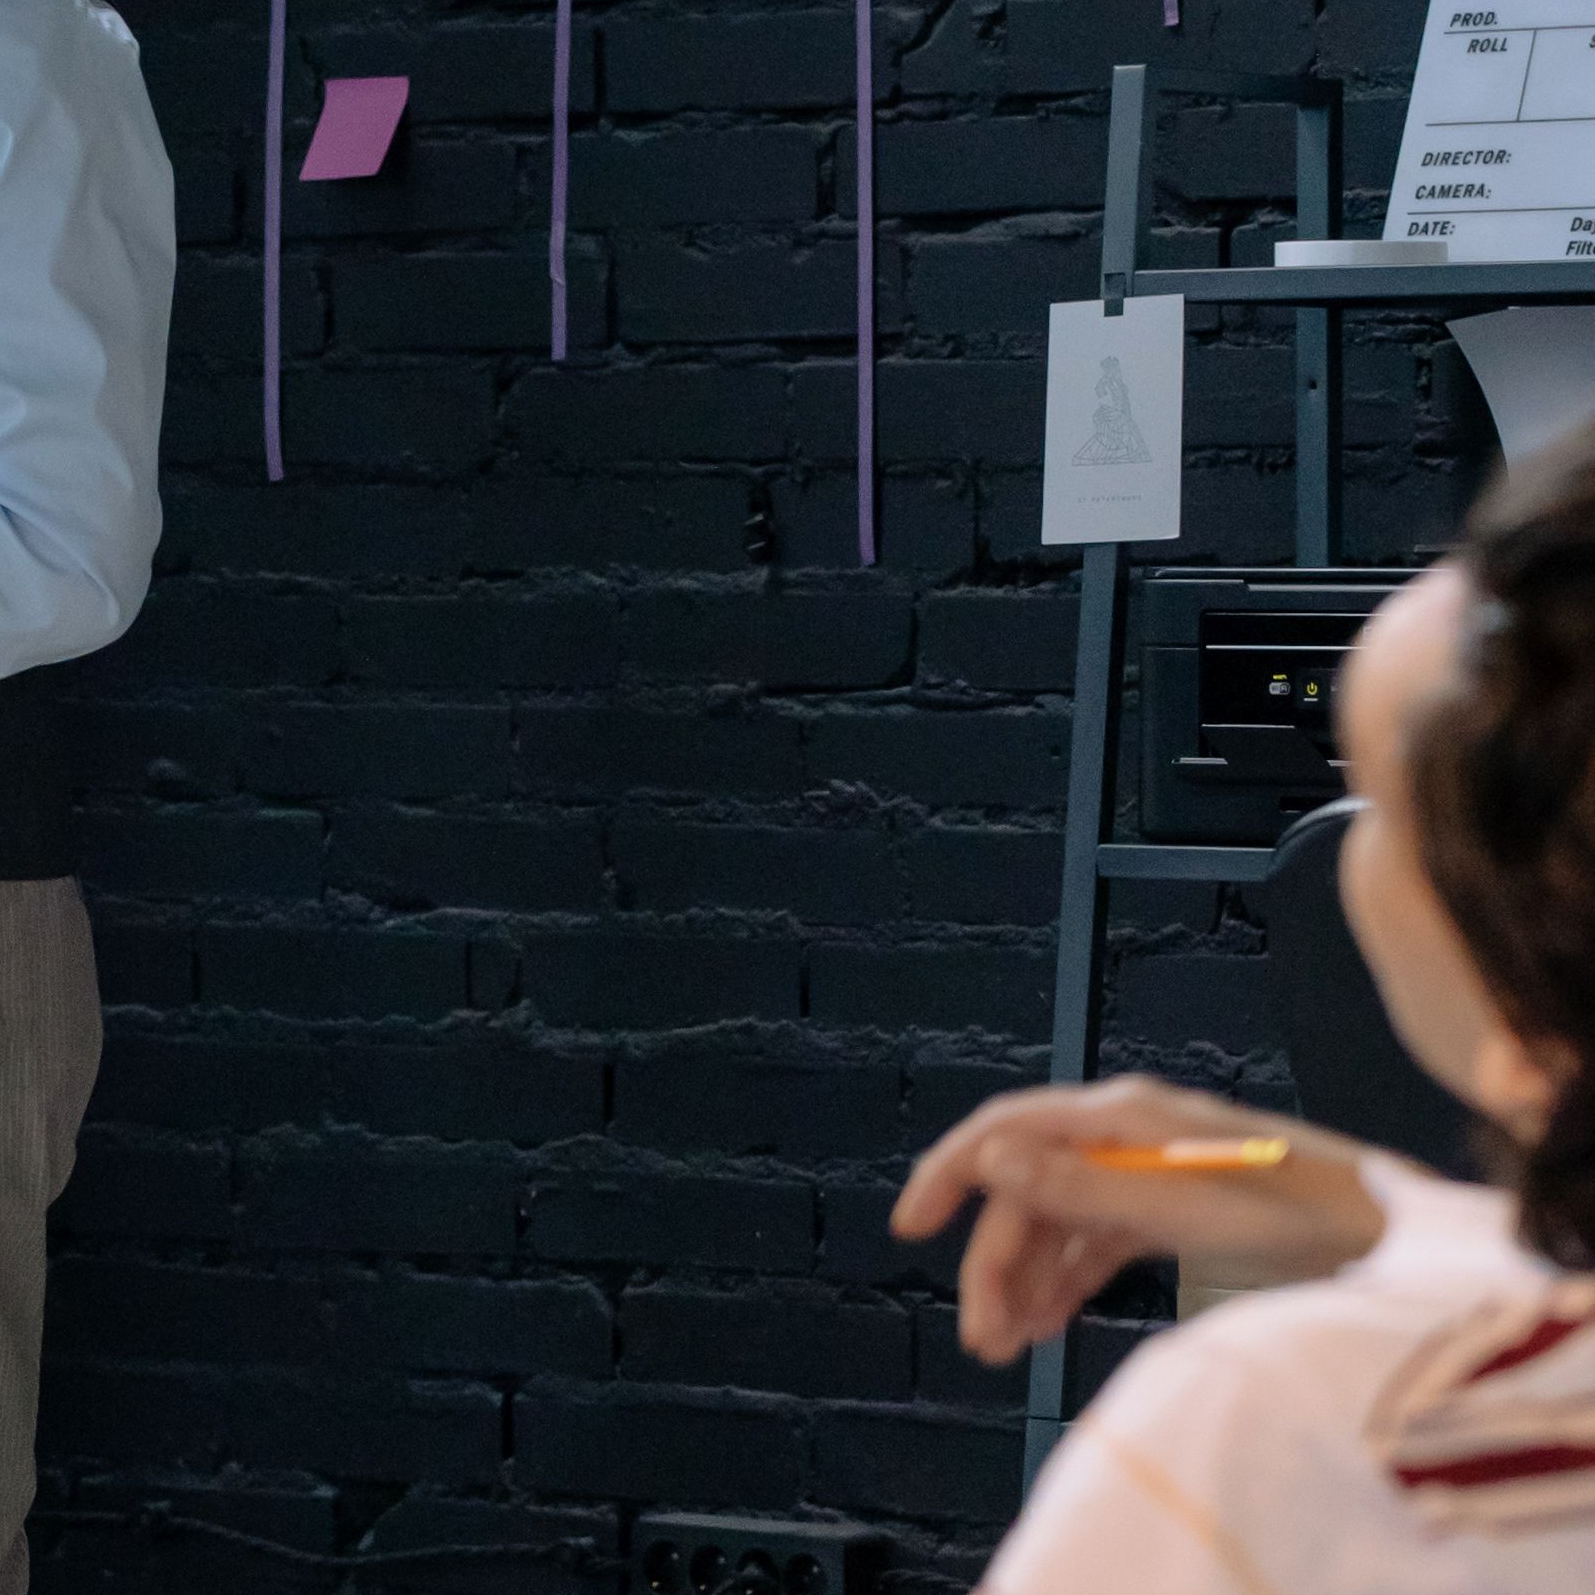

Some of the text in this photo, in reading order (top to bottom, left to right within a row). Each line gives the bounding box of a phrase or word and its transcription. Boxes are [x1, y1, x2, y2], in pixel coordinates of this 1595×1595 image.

[1449, 11, 1498, 28] PROD.
[1467, 37, 1508, 54] ROLL
[1420, 149, 1512, 168] DIRECTOR:
[1414, 183, 1492, 201] CAMERA:
[1407, 221, 1456, 237] DATE:
[1565, 240, 1595, 256] Filt
